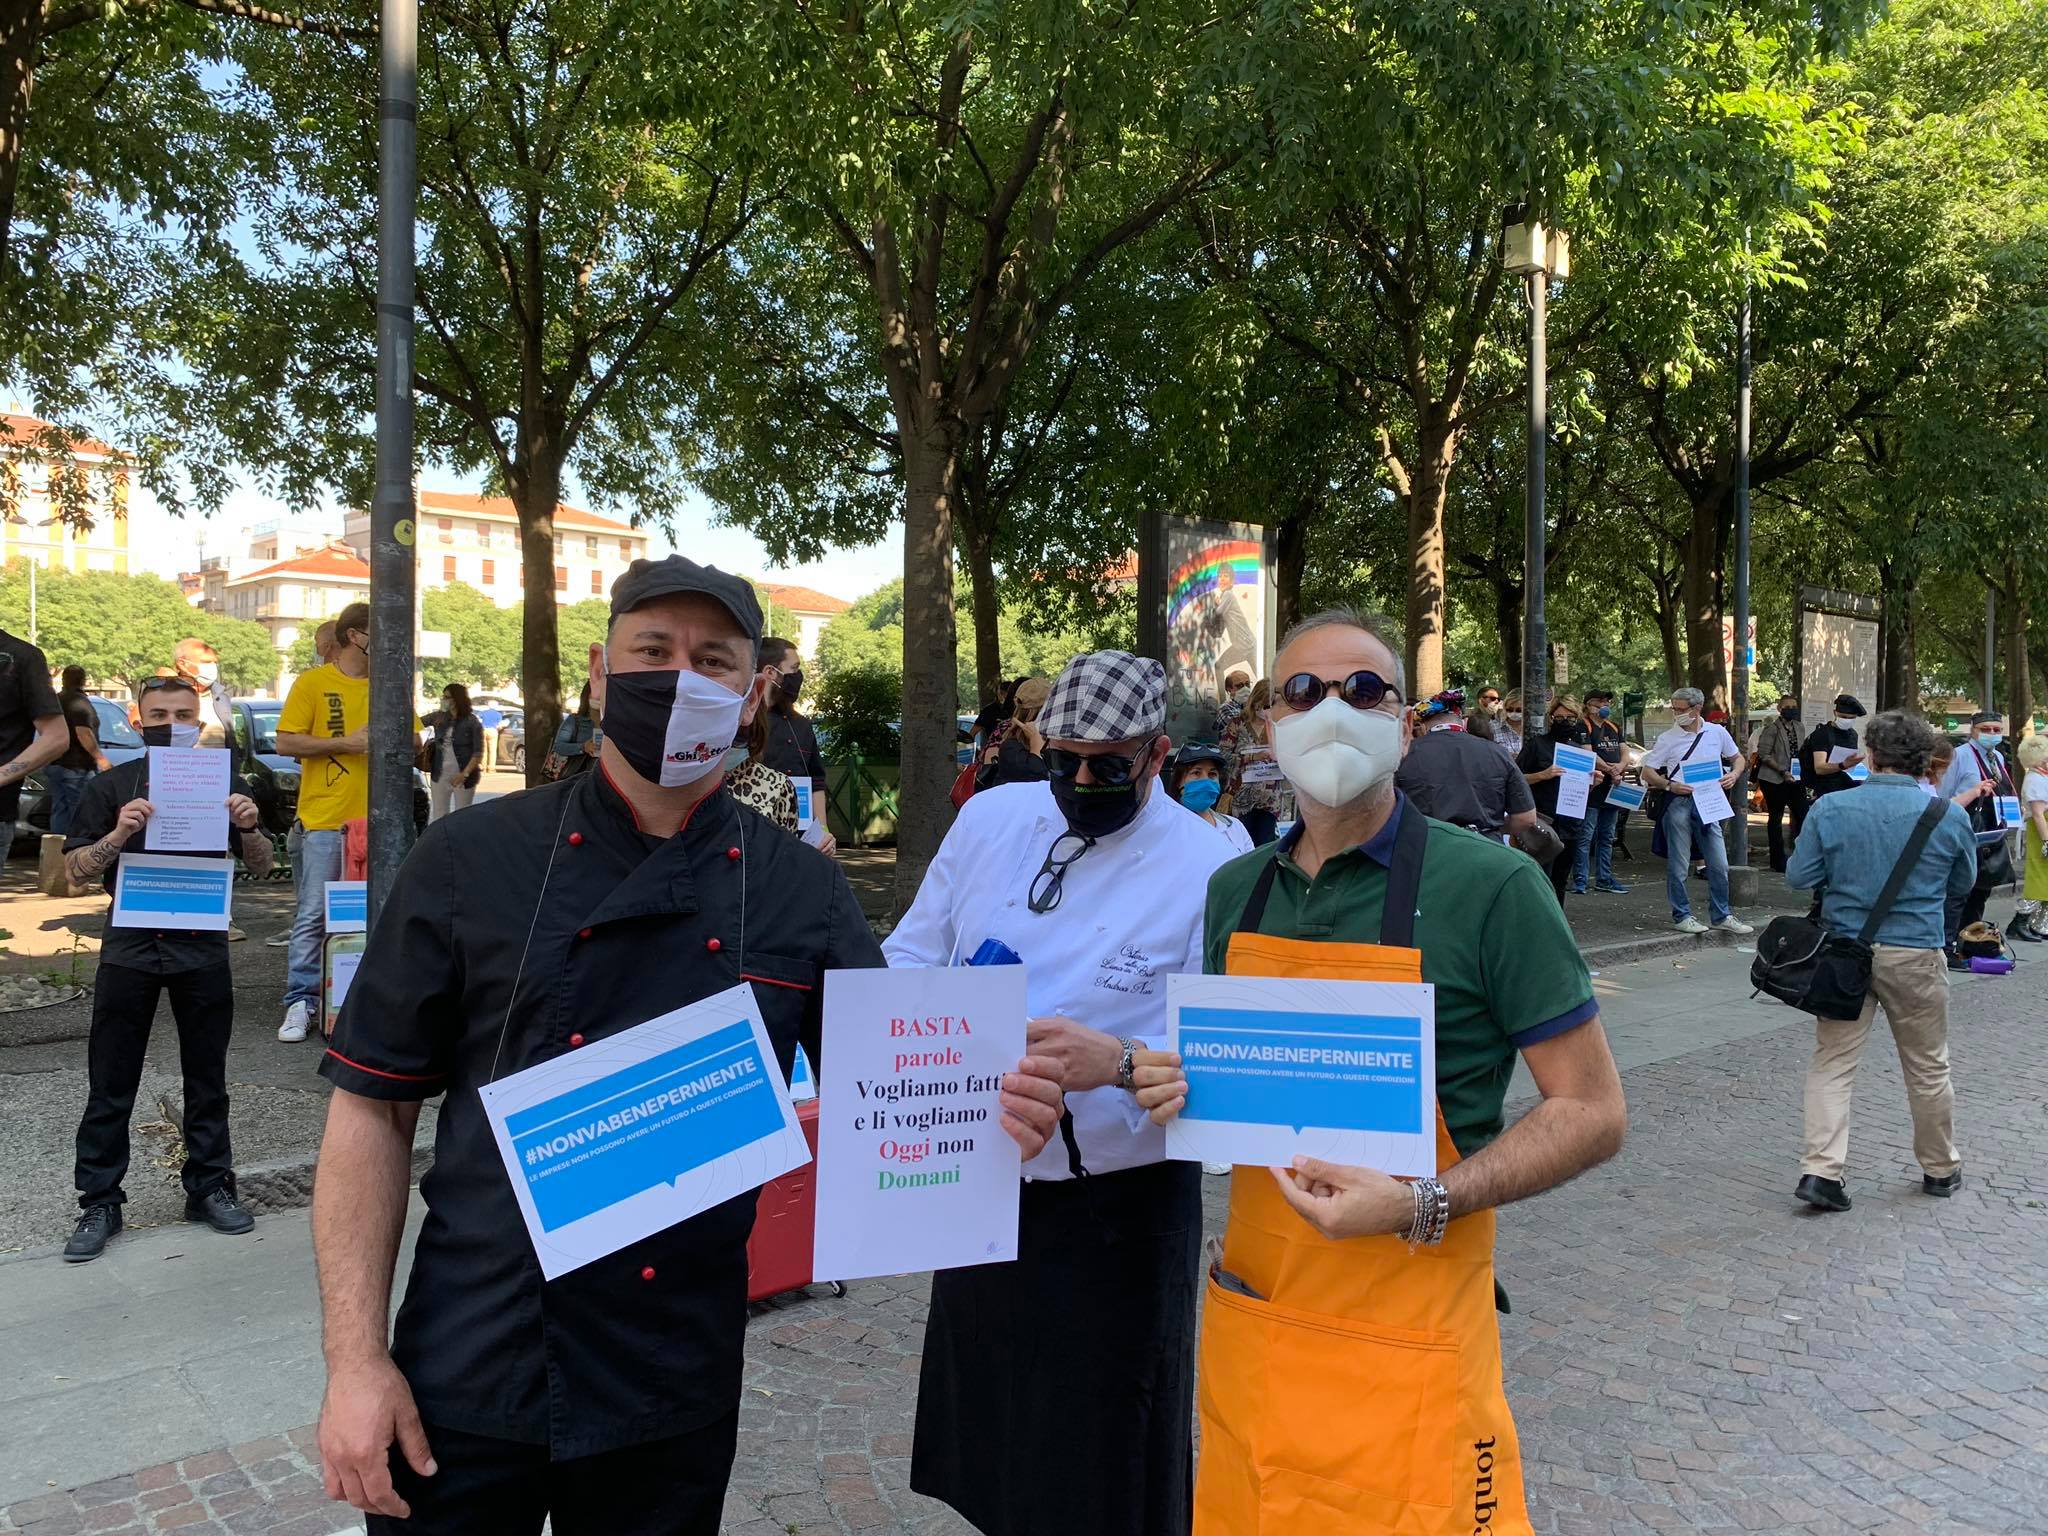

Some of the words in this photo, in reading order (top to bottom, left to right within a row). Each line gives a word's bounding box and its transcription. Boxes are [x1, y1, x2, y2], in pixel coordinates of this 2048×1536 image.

[125, 880, 224, 891] #NONVABENEPERNIENTE
[889, 1016, 971, 1037] BASTA
[895, 1047, 962, 1072] parole
[1184, 1042, 1413, 1069] #NONVABENEPERNIENTE
[1190, 1065, 1218, 1073] IMPRESE
[1237, 1067, 1271, 1076] POSSONO
[1272, 1069, 1294, 1077] AVERE
[1307, 1071, 1335, 1079] FUTURO
[1343, 1073, 1370, 1081] QUESTE
[1371, 1074, 1415, 1084] CONDIZIONI
[856, 1078, 958, 1104] Vogliamo
[525, 1057, 757, 1165] #NONVABENEPERNIENTE
[854, 1116, 866, 1130] e
[873, 1110, 885, 1129] li
[894, 1107, 987, 1132] vogliamo
[529, 1175, 539, 1183] LE
[539, 1161, 571, 1178] IMPRESE
[571, 1152, 589, 1165] NON
[590, 1137, 626, 1157] POSSONO
[626, 1127, 650, 1141] AVERE
[650, 1121, 661, 1132] UN
[661, 1110, 689, 1126] FUTURO
[696, 1095, 723, 1111] QUESTE
[723, 1078, 764, 1100] CONDIZIONI
[880, 1138, 930, 1163] Oggi
[937, 1138, 974, 1154] non
[878, 1164, 961, 1190] Domani
